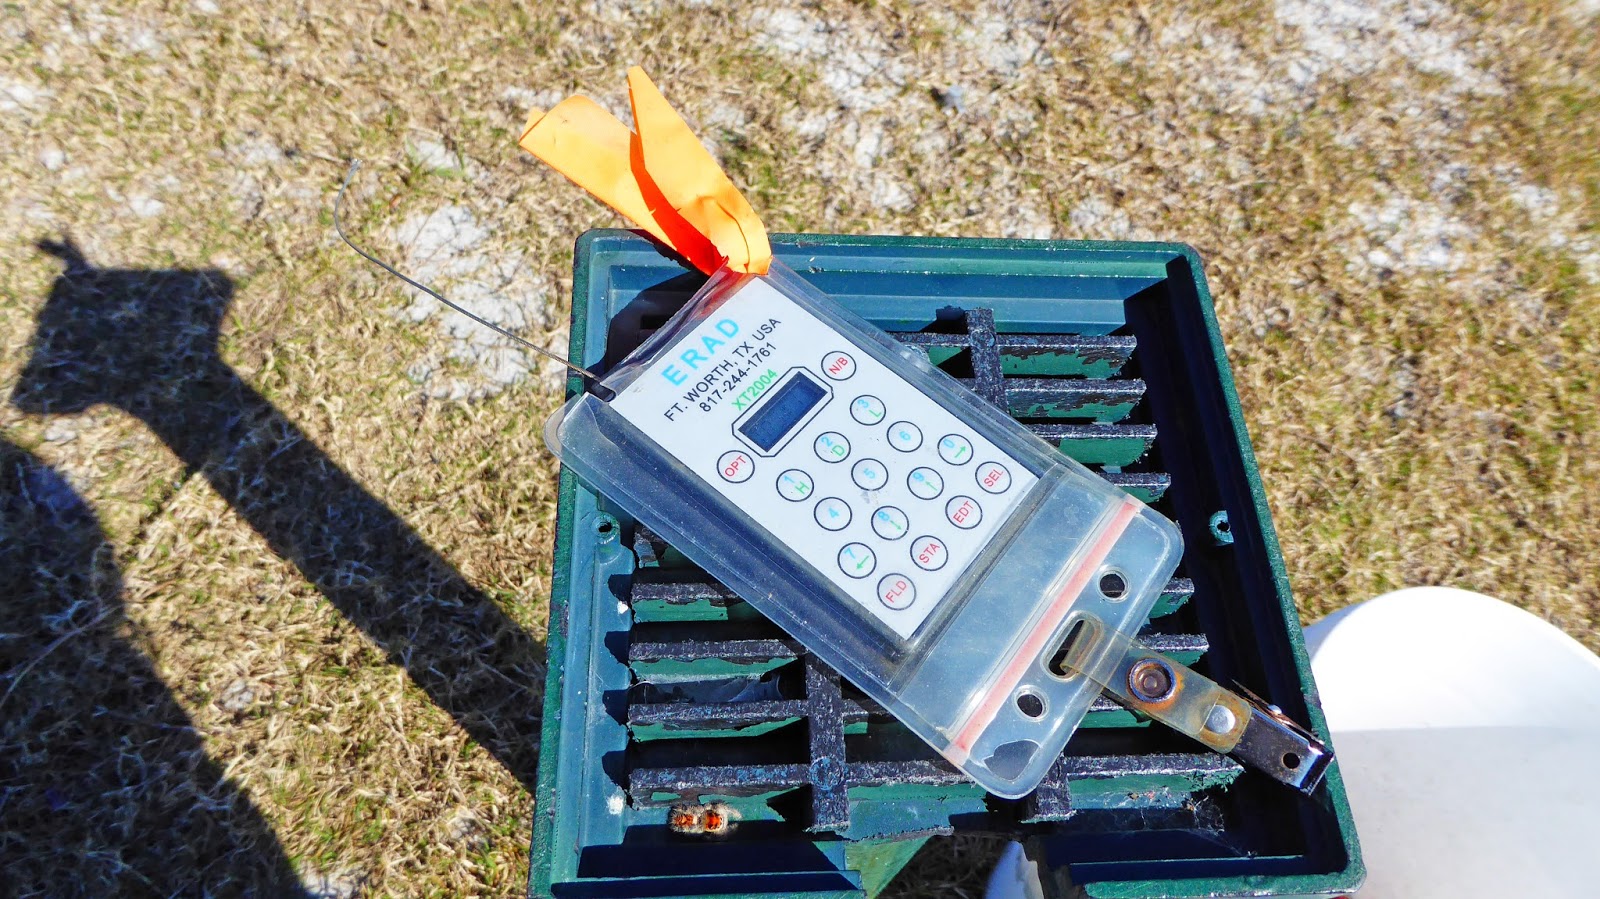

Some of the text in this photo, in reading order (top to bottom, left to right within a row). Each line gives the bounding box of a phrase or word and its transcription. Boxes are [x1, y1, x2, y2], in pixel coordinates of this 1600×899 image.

[661, 318, 740, 386] ERAD
[663, 318, 782, 422] FT. WORTH, TX USA
[828, 356, 849, 375] N/B
[699, 342, 777, 412] 817-244-1761
[731, 368, 778, 411] XT2004
[899, 430, 911, 441] 6
[831, 444, 845, 457] D
[724, 455, 747, 477] OPT
[863, 468, 876, 480] 5
[794, 481, 810, 495] H
[983, 469, 1004, 487] SEL
[953, 500, 974, 524] EDT
[918, 542, 941, 565] STA
[885, 580, 907, 604] FLD
